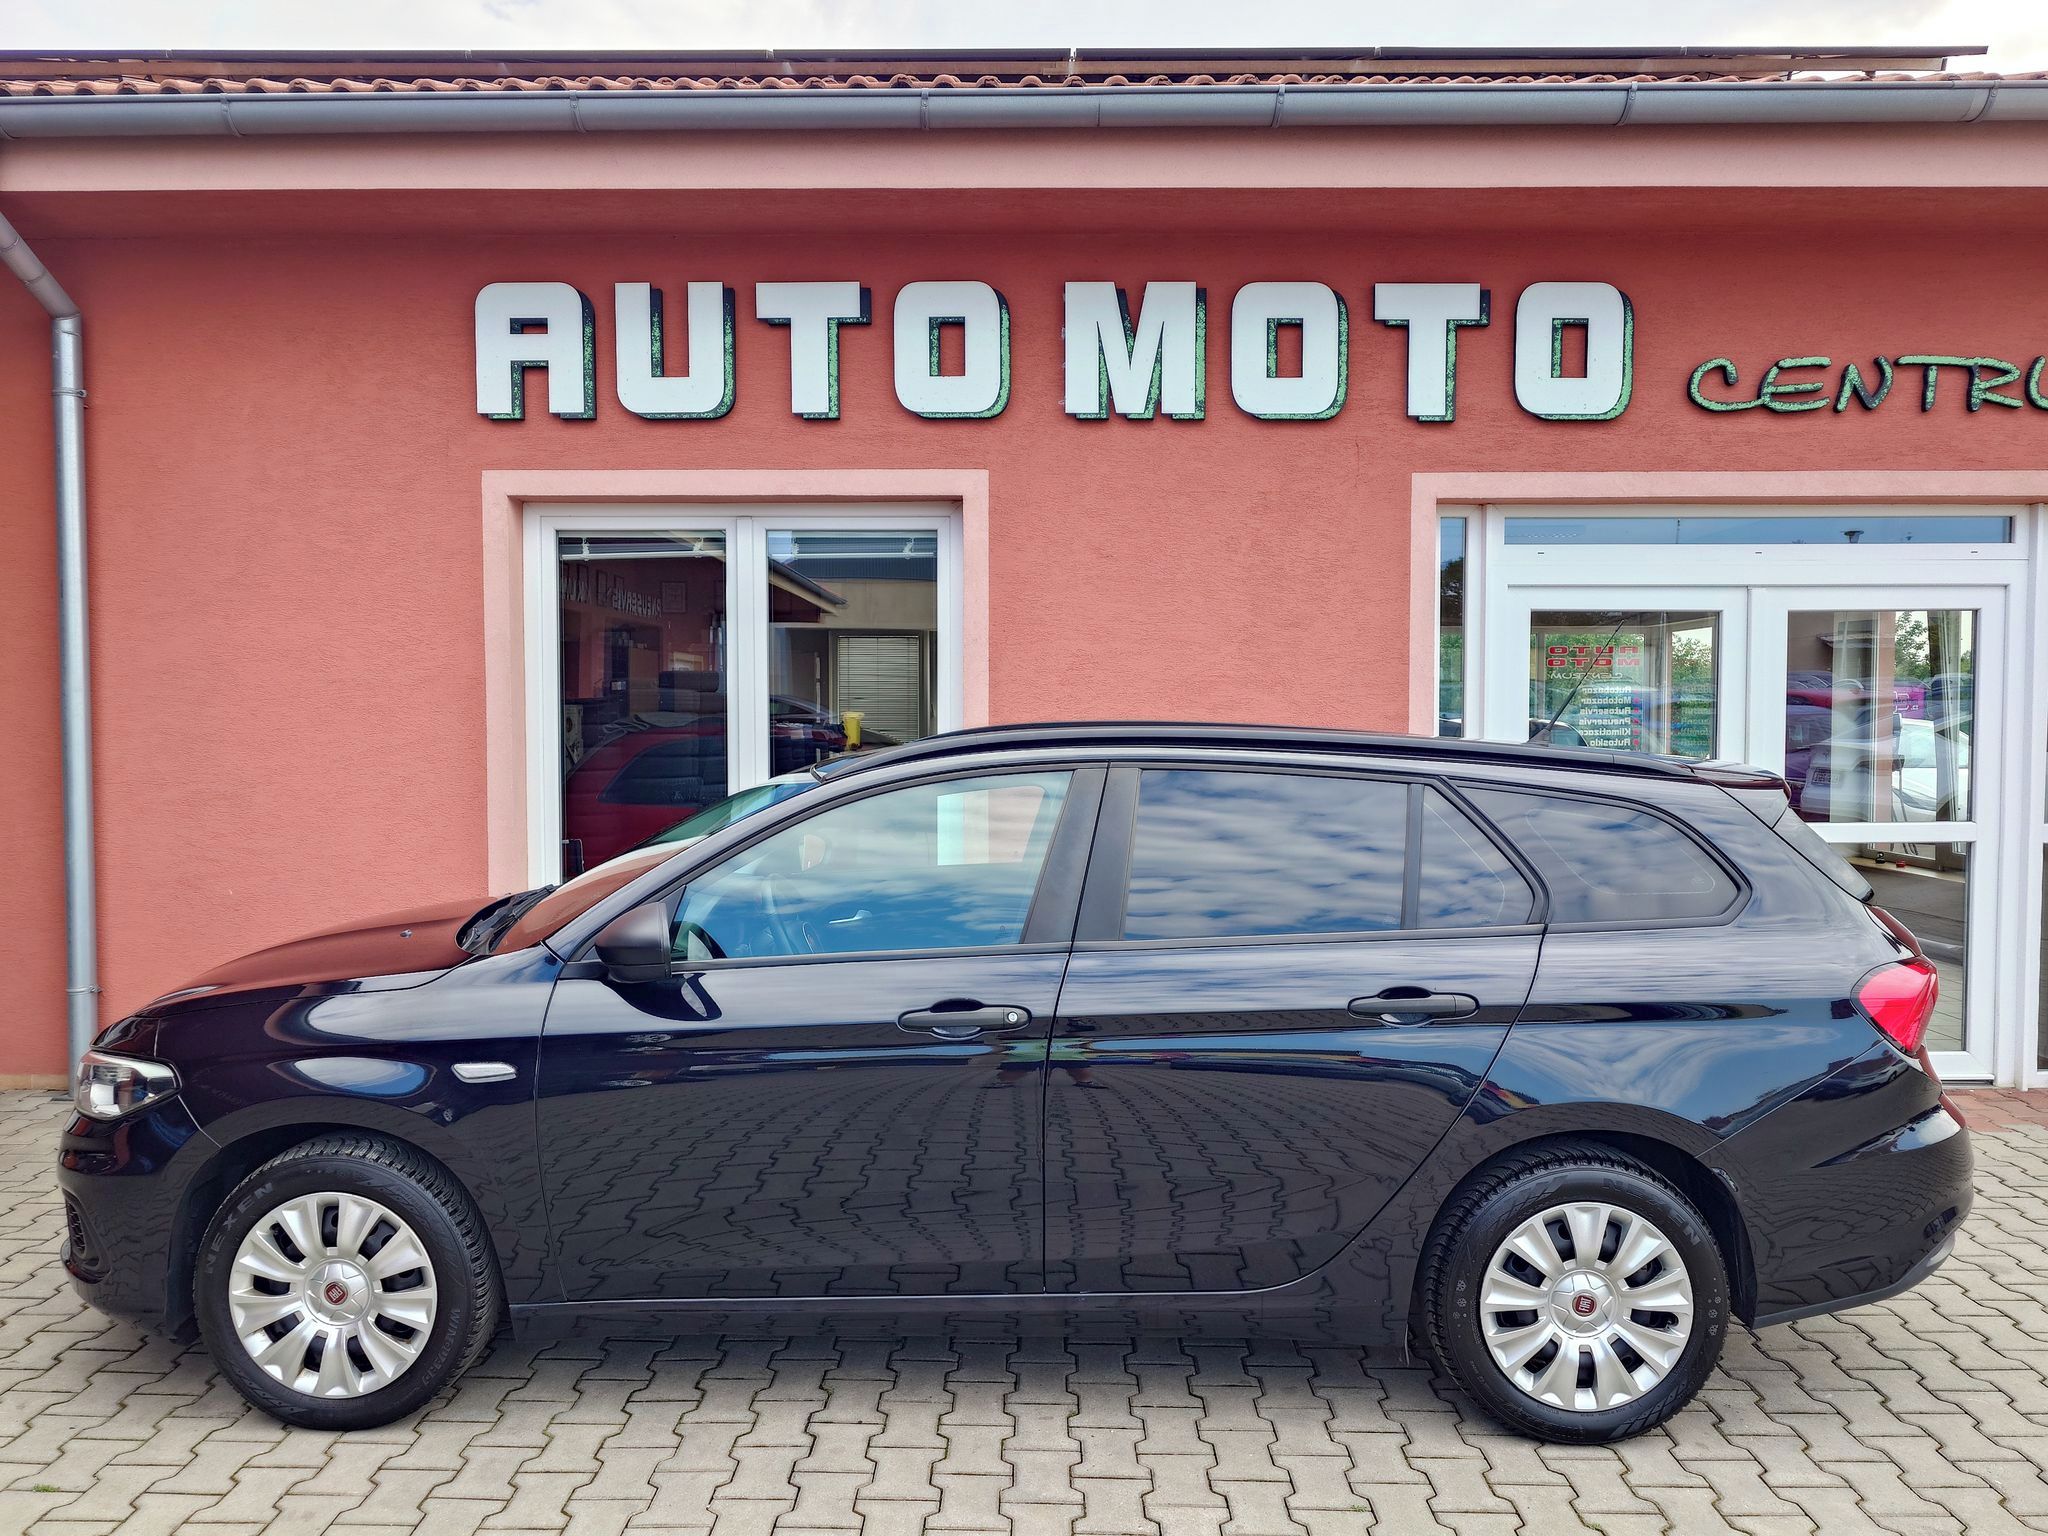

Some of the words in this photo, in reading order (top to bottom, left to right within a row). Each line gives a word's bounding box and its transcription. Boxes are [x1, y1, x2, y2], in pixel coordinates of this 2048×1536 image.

[474, 280, 1011, 420] AUTO
[1063, 280, 1634, 422] MOTO
[206, 1182, 273, 1274] NEXEN
